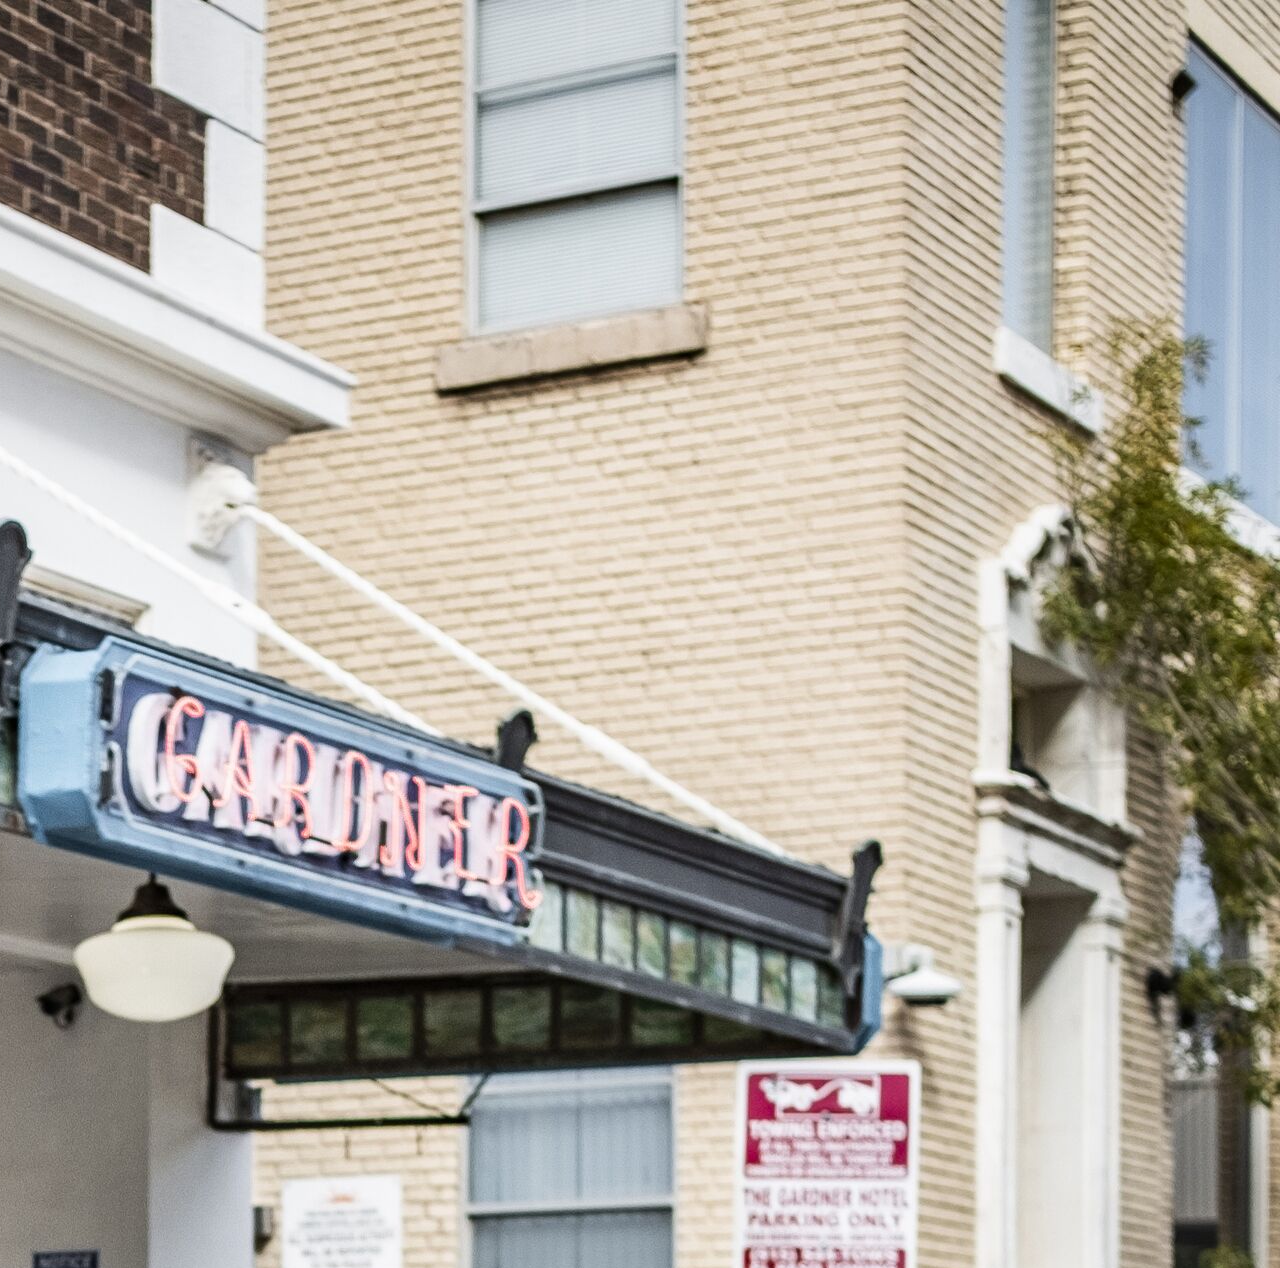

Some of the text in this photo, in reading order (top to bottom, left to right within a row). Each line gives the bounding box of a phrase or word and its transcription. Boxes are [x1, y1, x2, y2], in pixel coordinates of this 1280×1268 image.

[128, 692, 542, 909] GARDNER
[817, 1120, 907, 1141] ENFORCED
[744, 1188, 908, 1208] THE GARDNER HOTEL
[748, 1213, 900, 1228] PARKING ONLY
